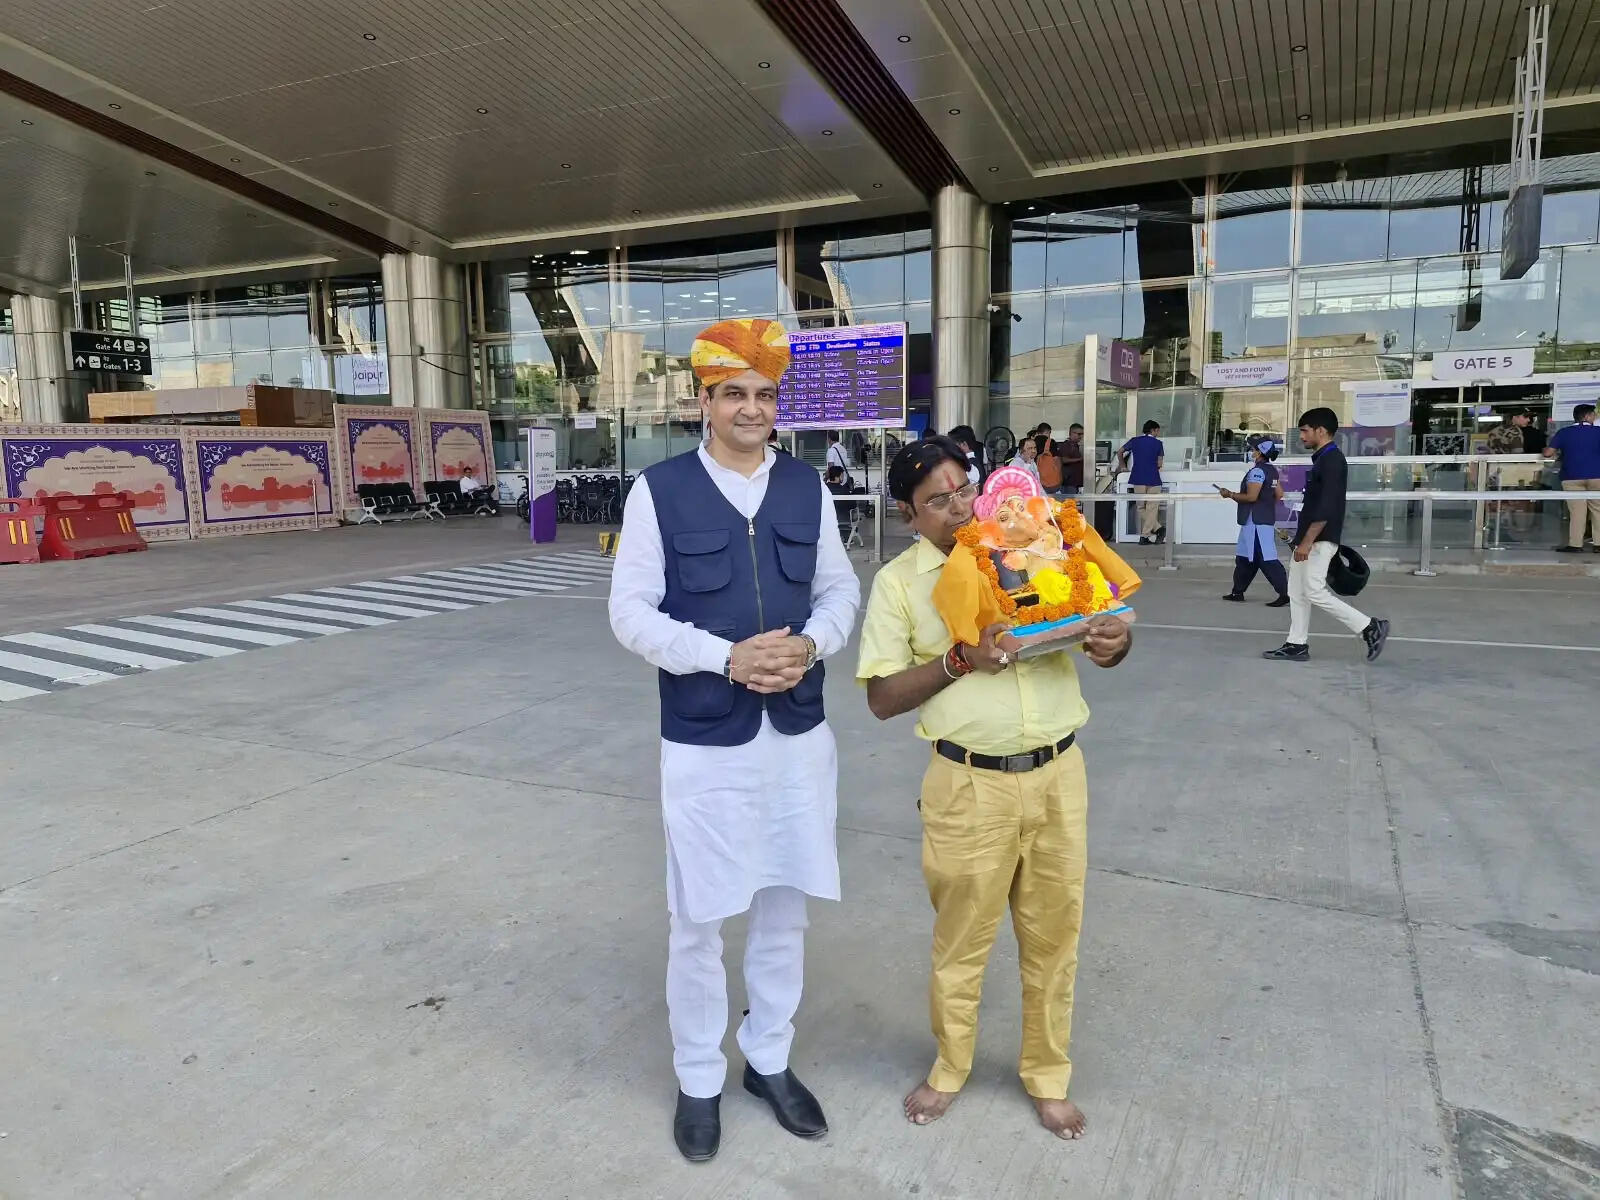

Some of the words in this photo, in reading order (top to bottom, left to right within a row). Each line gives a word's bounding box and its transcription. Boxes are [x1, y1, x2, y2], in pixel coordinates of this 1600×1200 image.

[788, 333, 835, 343] Departures
[95, 343, 111, 351] Gate
[112, 338, 122, 352] 4
[103, 363, 122, 371] Gates
[122, 358, 142, 372] 1-3
[1453, 357, 1497, 370] GATE
[1502, 356, 1513, 368] 5
[353, 369, 384, 382] Jaipur
[1217, 367, 1234, 375] LOST
